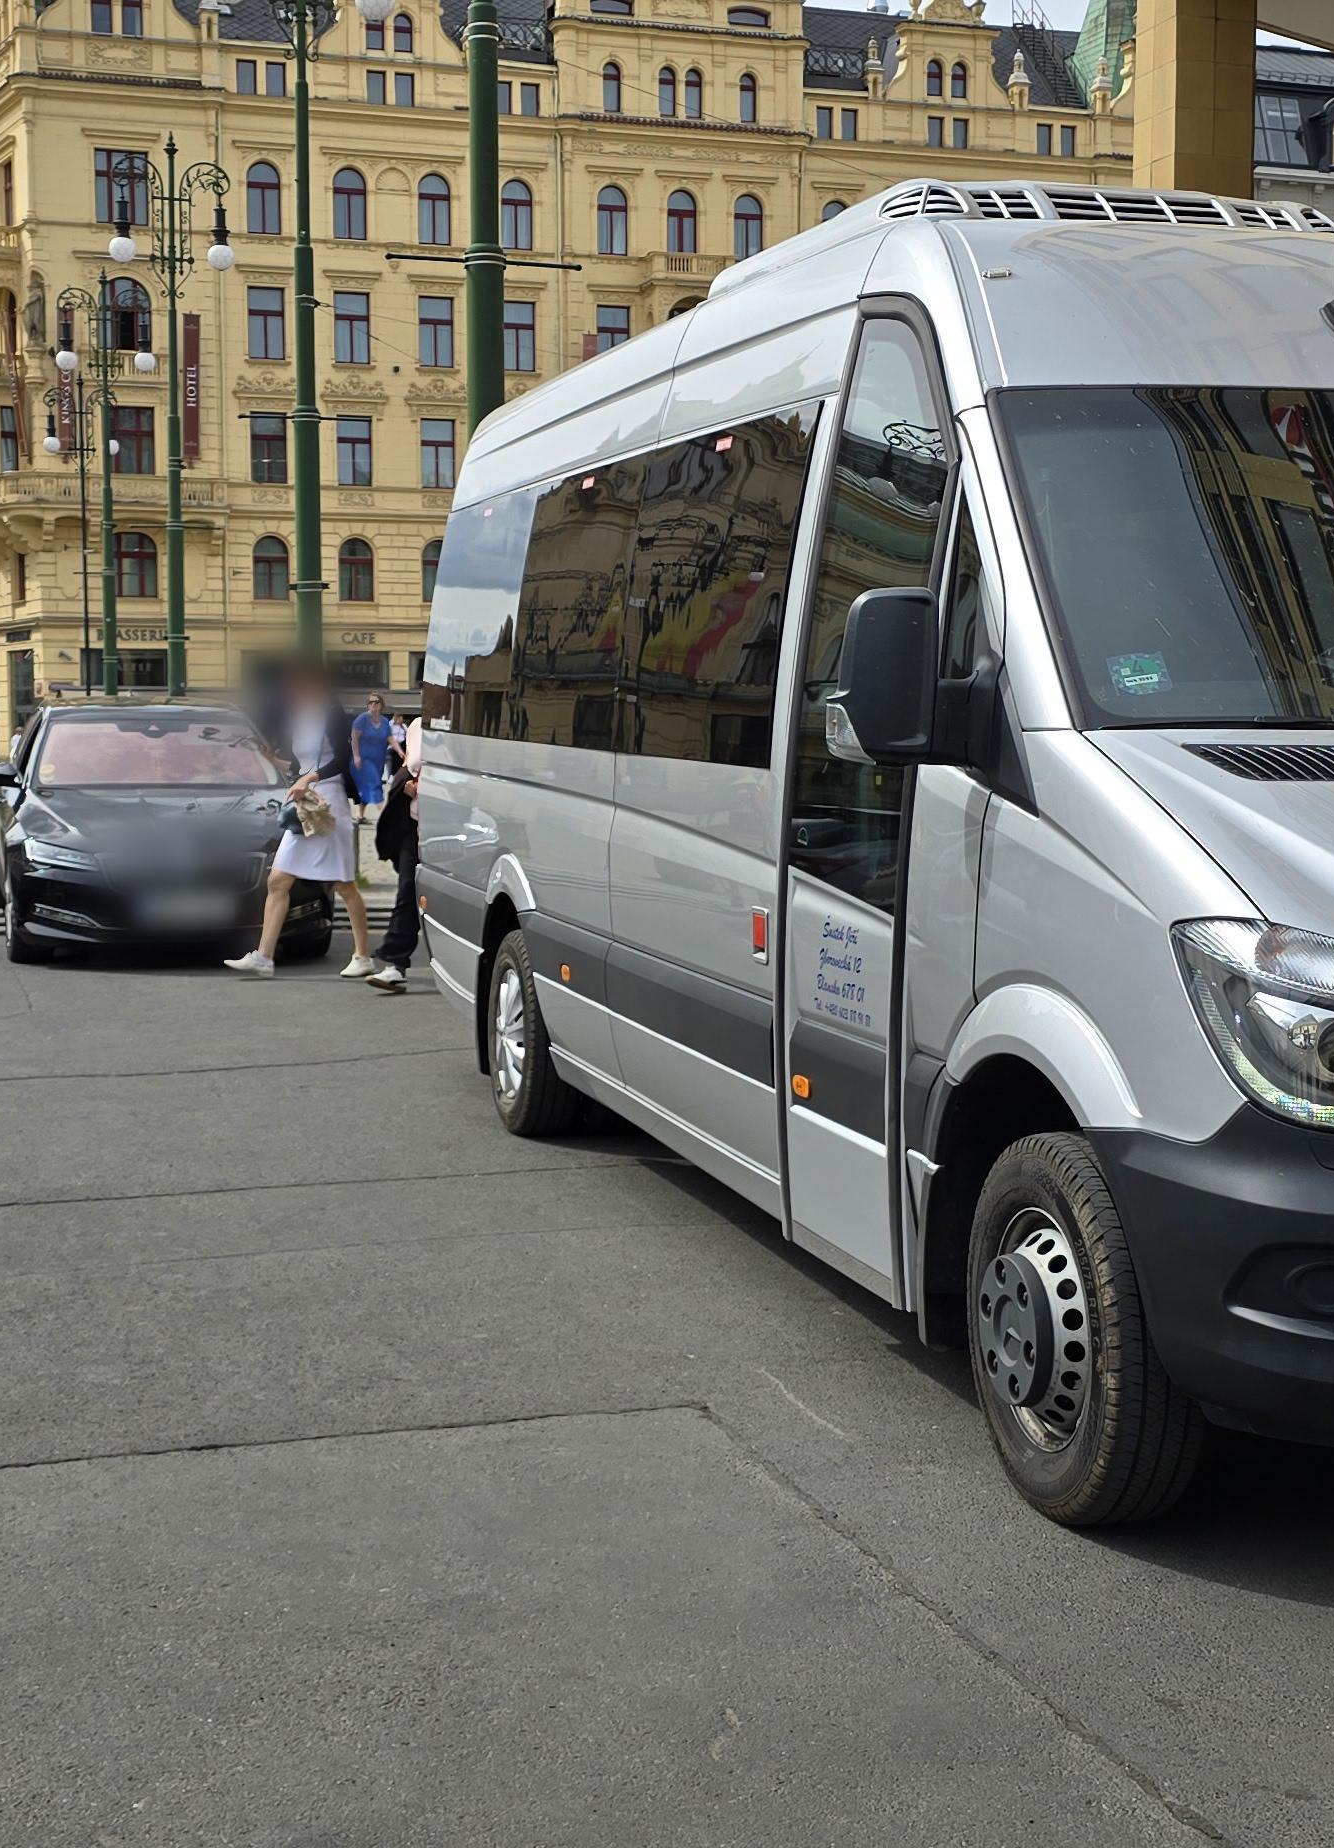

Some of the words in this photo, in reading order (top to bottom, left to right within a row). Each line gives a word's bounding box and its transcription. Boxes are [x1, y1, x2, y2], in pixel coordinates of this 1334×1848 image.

[186, 364, 197, 407] HOTEL
[96, 628, 168, 641] BASSERI
[341, 632, 376, 644] CAFE
[852, 957, 862, 973] 12
[842, 983, 856, 1000] 678
[1074, 1239, 1094, 1290] 205/75
